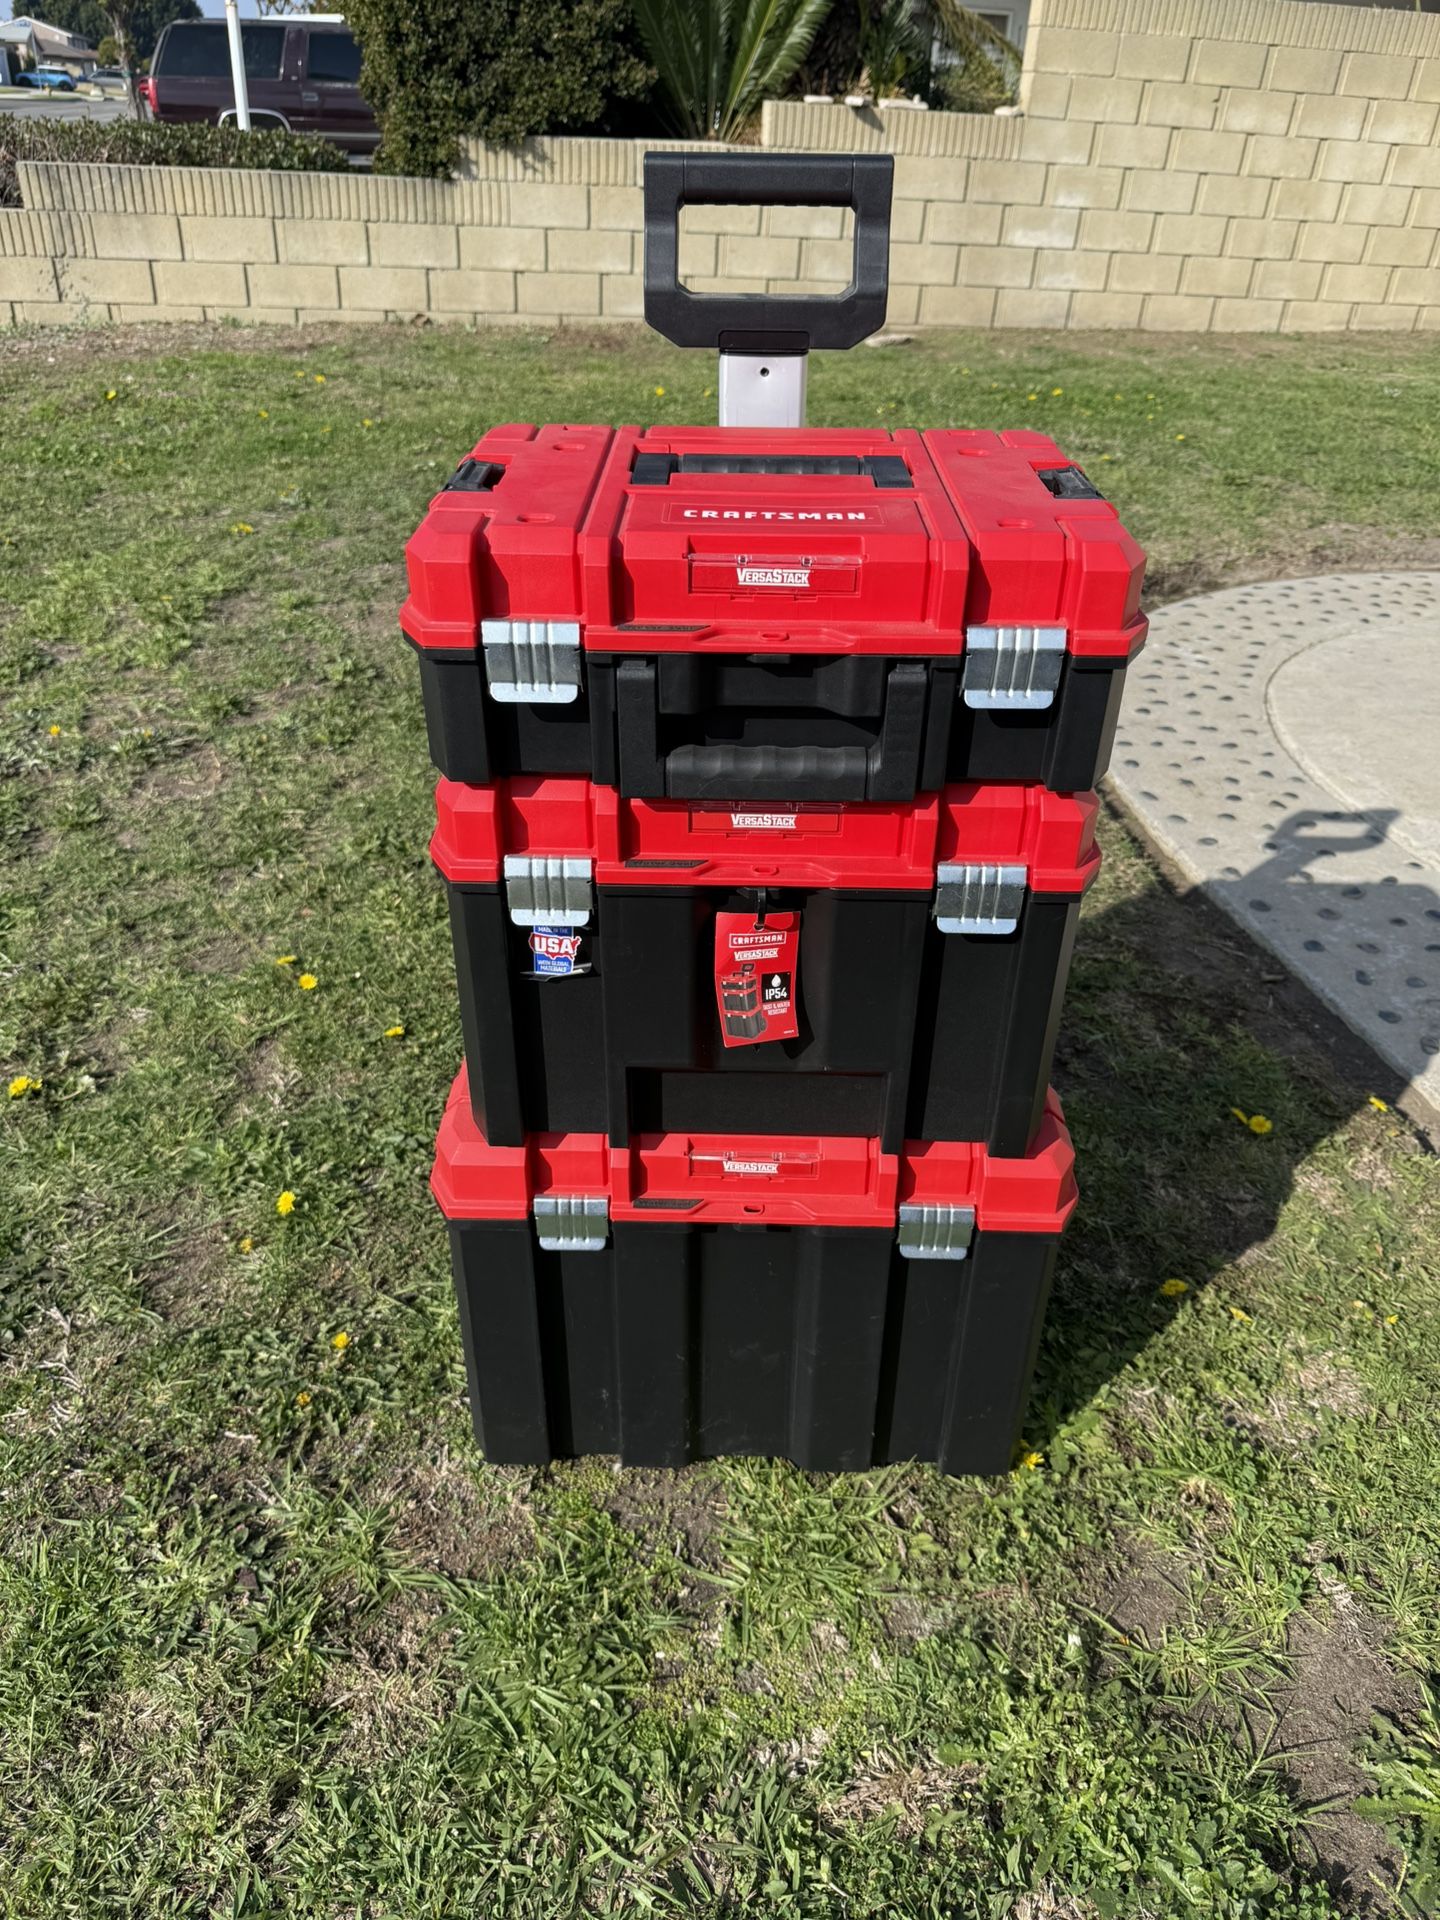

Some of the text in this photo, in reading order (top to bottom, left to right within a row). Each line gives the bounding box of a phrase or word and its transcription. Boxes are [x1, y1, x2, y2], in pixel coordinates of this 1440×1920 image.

[684, 510, 866, 520] CRAFTSMAN
[733, 934, 782, 944] CRAFTSMAN
[534, 936, 574, 954] USA
[766, 988, 788, 1000] IP54
